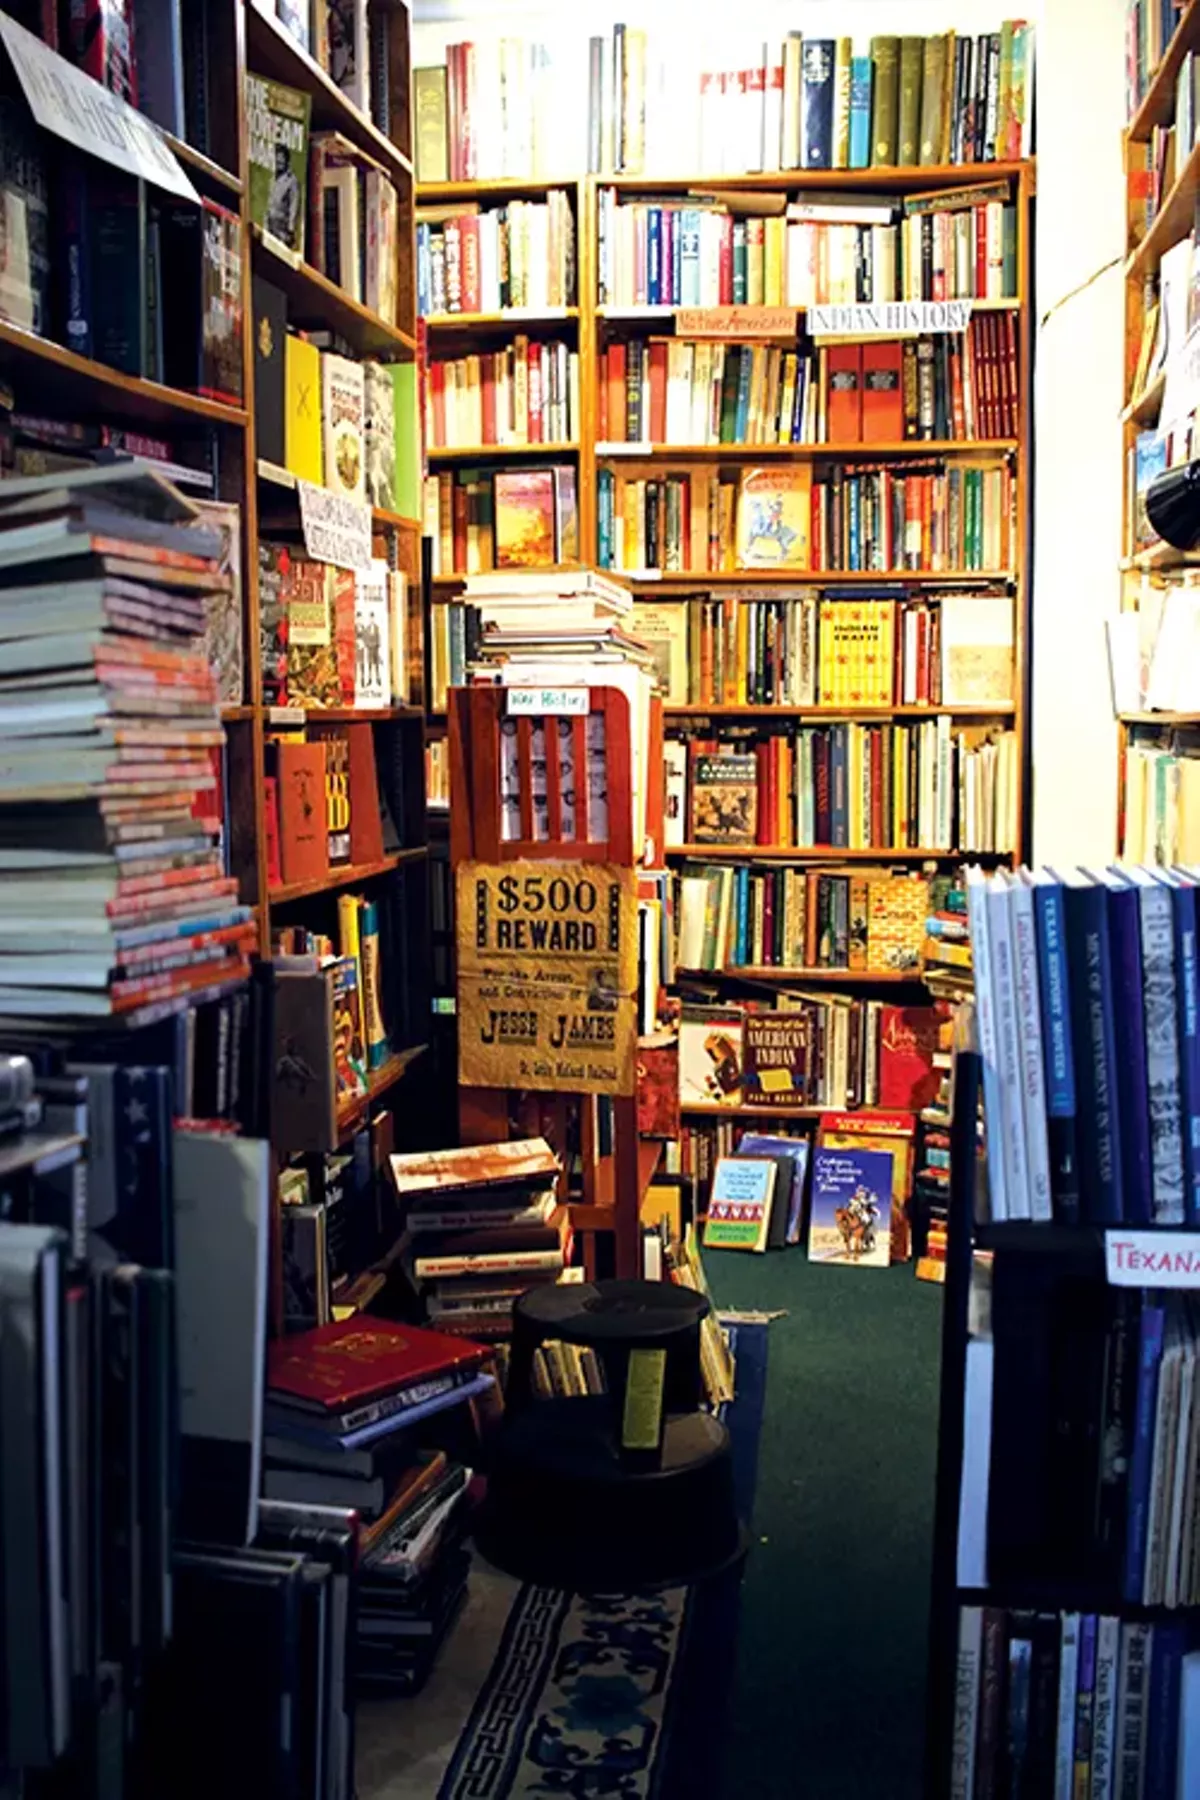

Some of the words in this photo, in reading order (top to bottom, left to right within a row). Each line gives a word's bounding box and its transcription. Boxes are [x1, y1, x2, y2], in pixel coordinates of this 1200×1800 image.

[809, 308, 880, 331] INDIAN
[887, 302, 970, 329] HISTORY
[498, 875, 597, 914] $500
[497, 919, 597, 950] REWARD
[1044, 897, 1057, 951] TEXAS
[1016, 911, 1038, 1021] Landscapes
[1047, 953, 1062, 1017] HISTORY
[481, 1010, 537, 1043] JESSE
[550, 1015, 615, 1048] JAMES
[748, 1031, 806, 1047] AMERICAN
[755, 1048, 796, 1065] INDIAN
[955, 1650, 975, 1735] HEROES
[954, 1741, 969, 1774] OF
